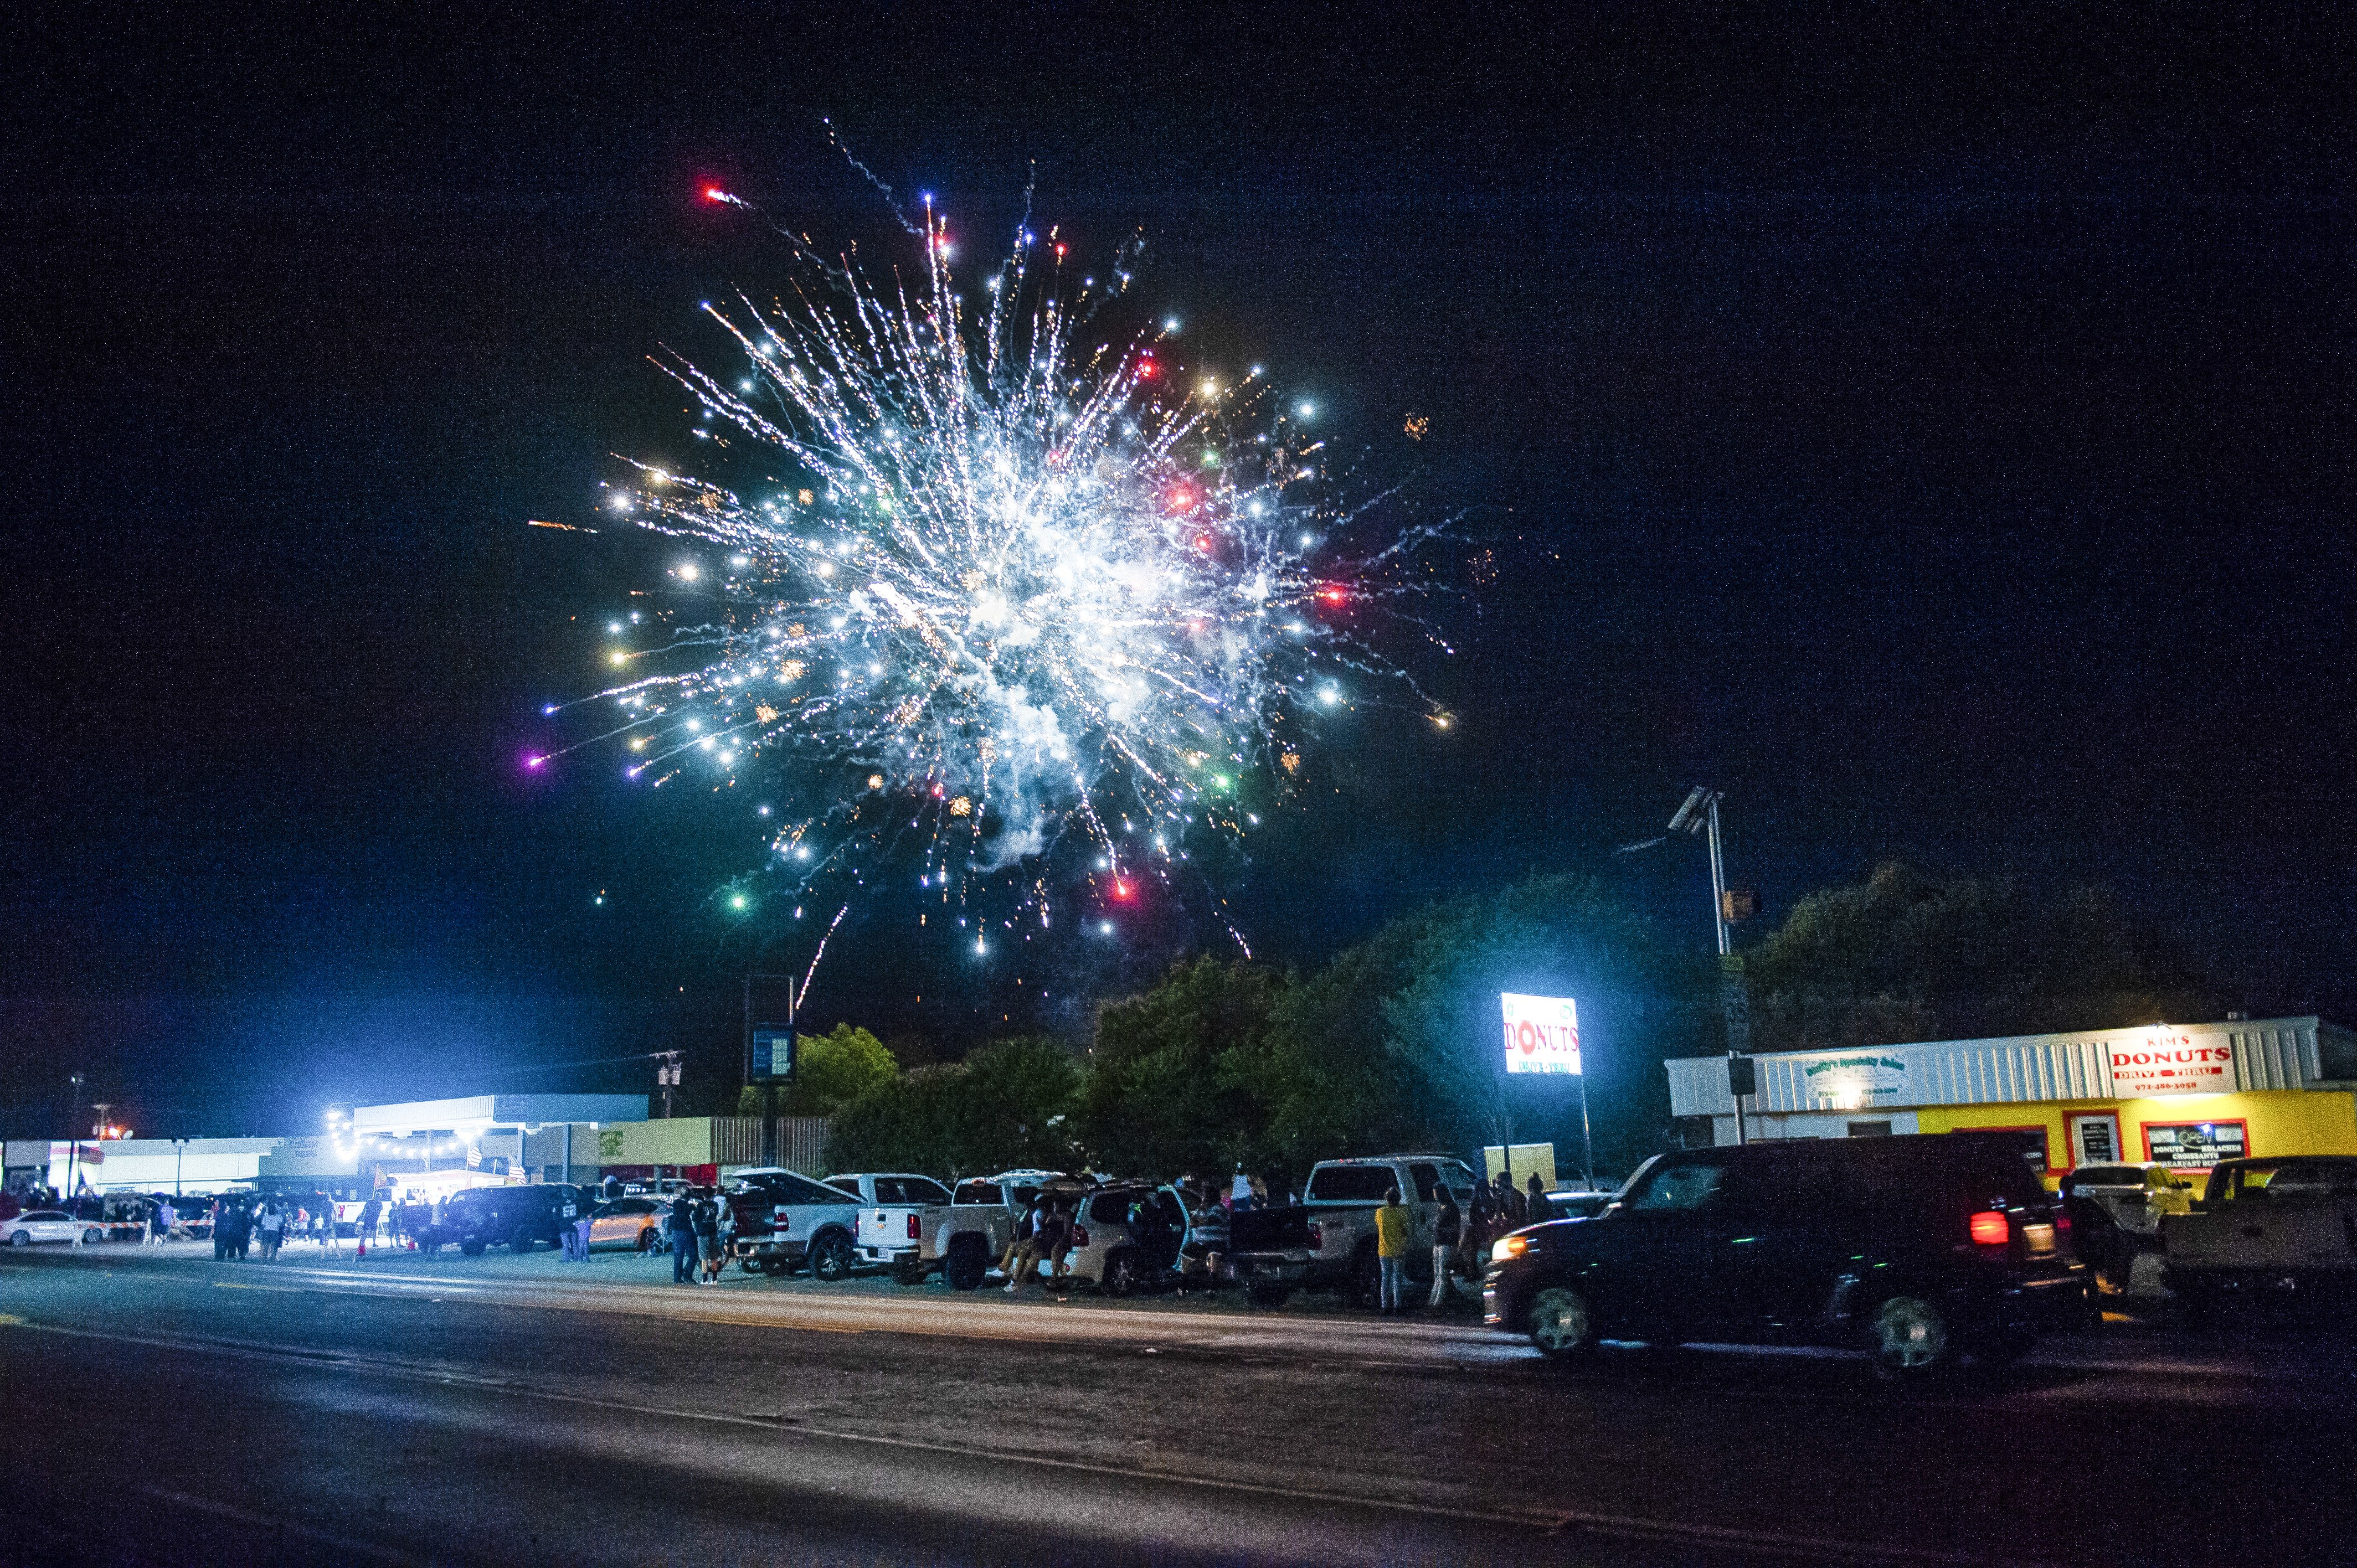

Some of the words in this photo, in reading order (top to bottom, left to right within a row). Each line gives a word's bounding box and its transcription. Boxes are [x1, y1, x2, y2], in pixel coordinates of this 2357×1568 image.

[1504, 1020, 1579, 1056] DONUTS
[2147, 1036, 2190, 1046] KIM'S
[2112, 1047, 2231, 1066] DONUTS
[2119, 1070, 2161, 1079] DRIVE
[2173, 1067, 2212, 1077] THRU
[2201, 1144, 2242, 1153] KOLACHES
